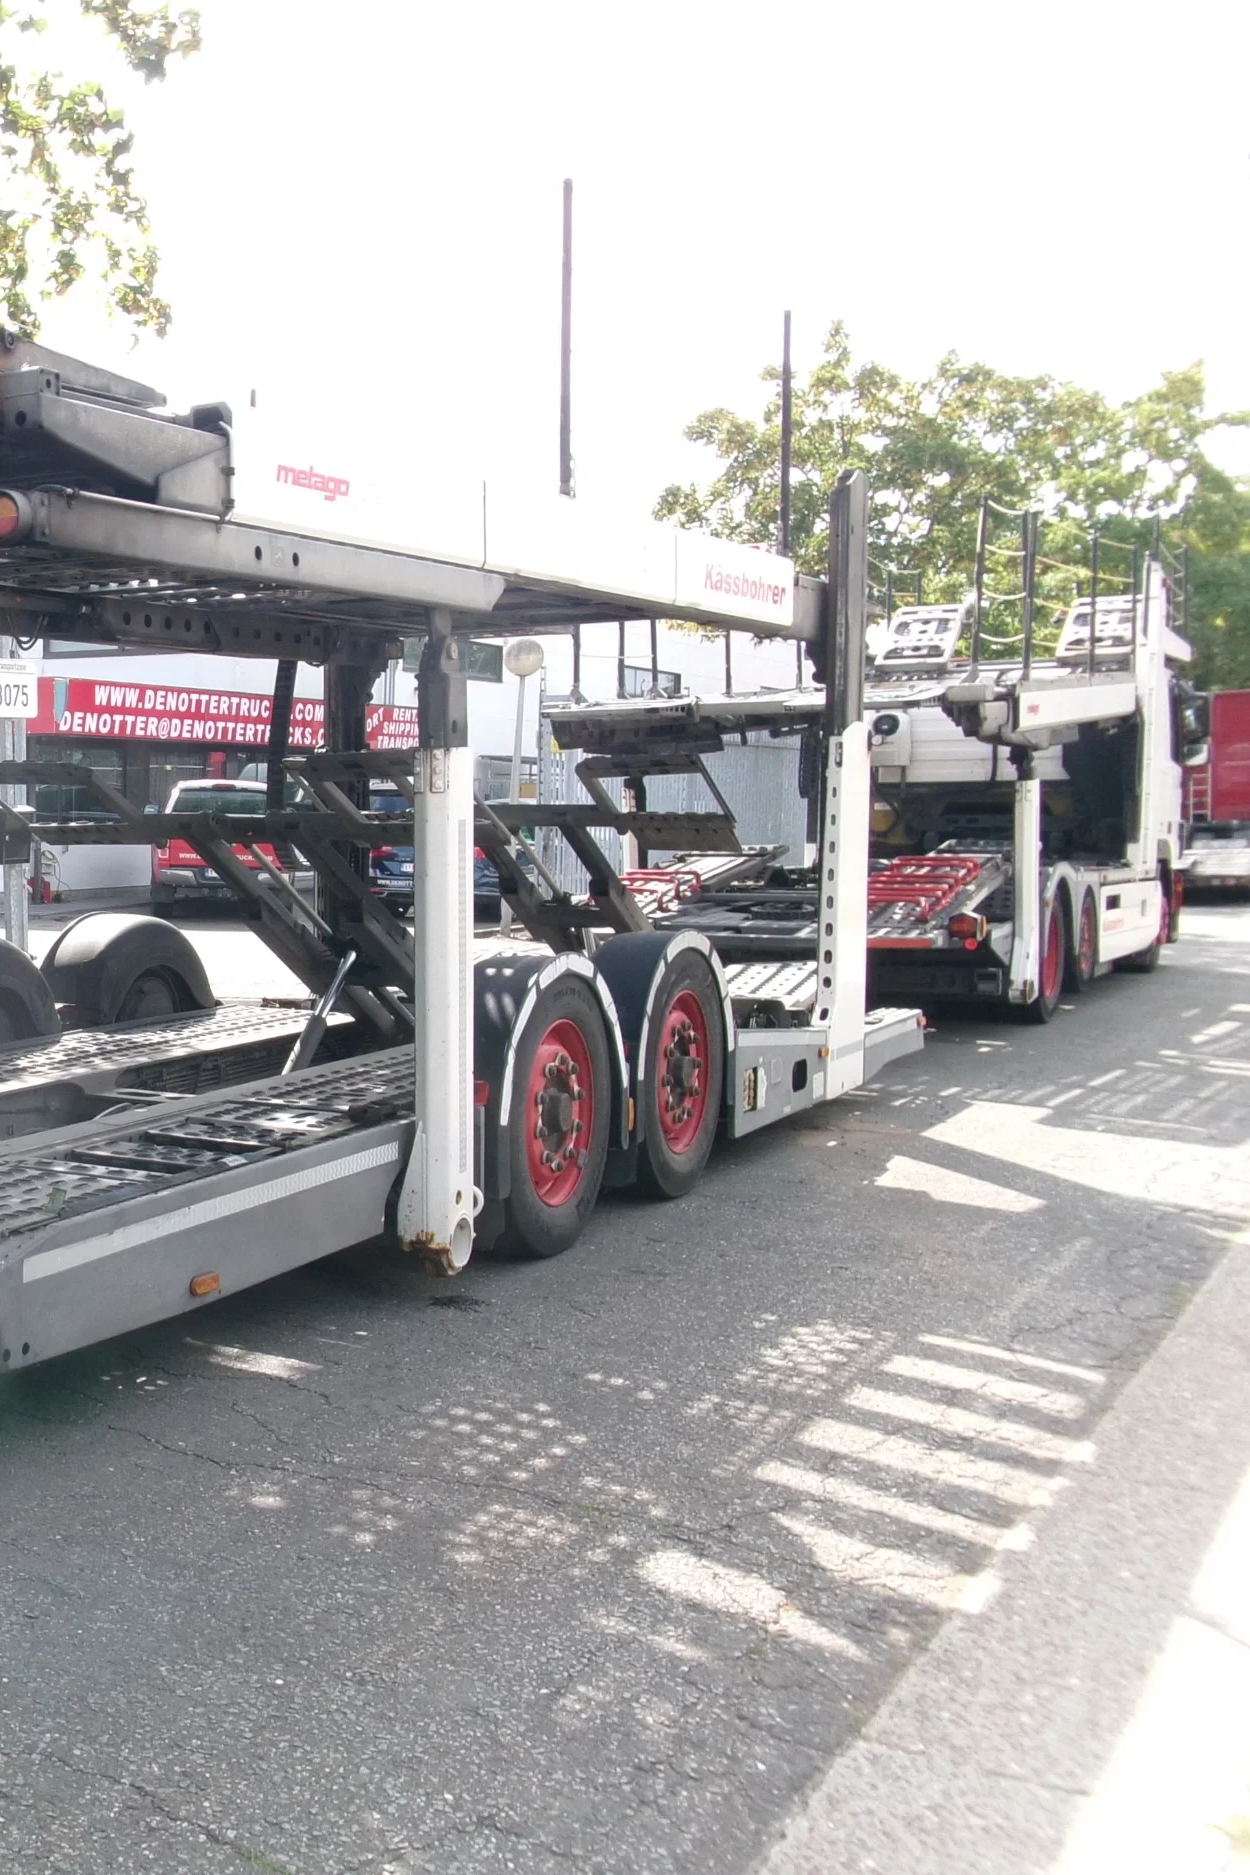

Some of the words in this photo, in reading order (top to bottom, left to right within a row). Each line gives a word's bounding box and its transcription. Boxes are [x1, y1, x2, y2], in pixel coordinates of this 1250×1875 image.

[276, 464, 350, 501] metago
[704, 563, 787, 605] Kässbohrer
[94, 685, 325, 722] WWW.DENOTTERTRUC.COM
